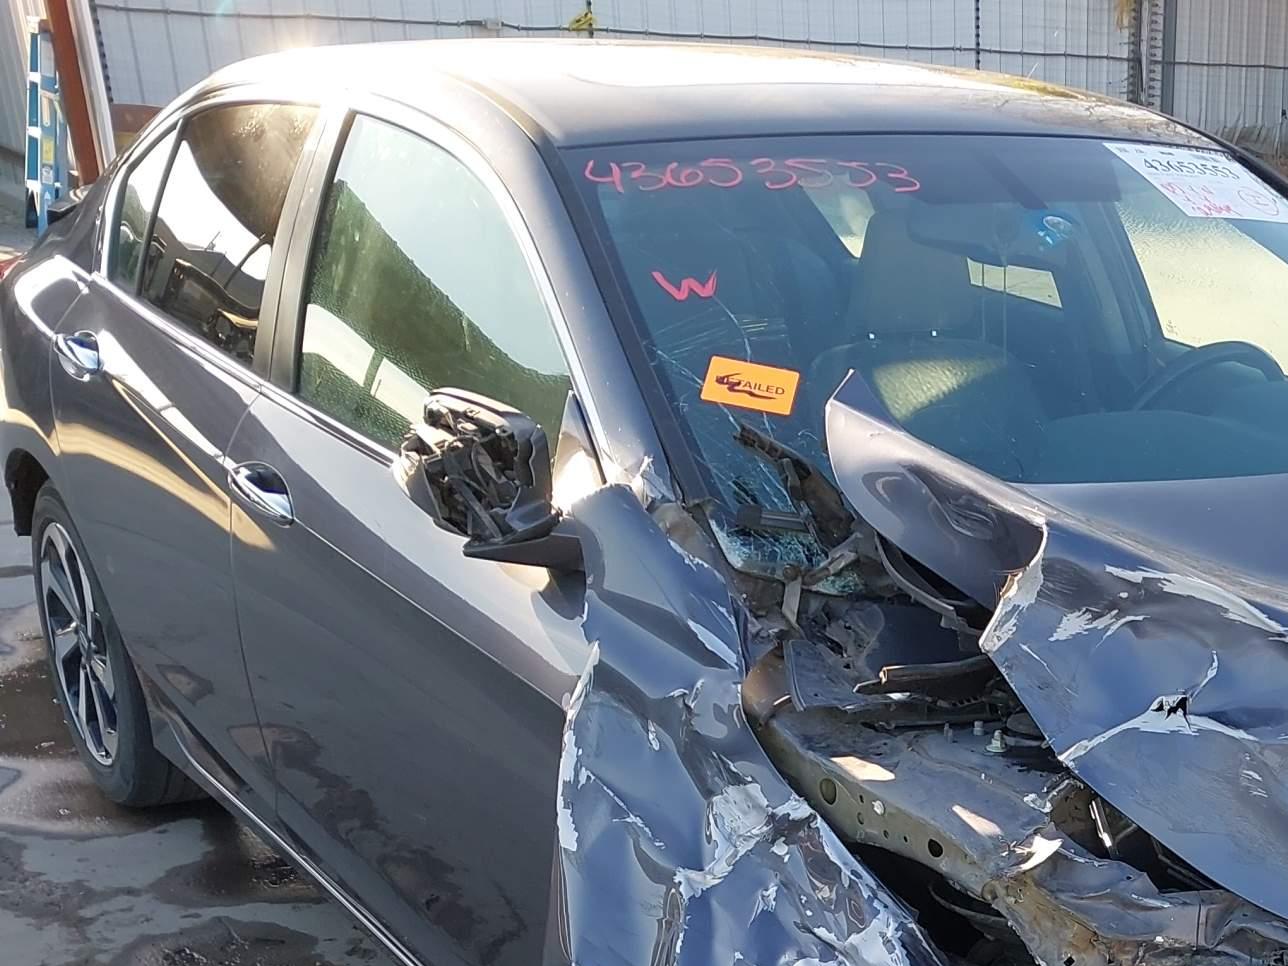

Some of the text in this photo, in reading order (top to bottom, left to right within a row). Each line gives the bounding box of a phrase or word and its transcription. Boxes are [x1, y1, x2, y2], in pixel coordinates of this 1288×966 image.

[584, 158, 921, 193] 43653553
[652, 268, 717, 301] W
[716, 375, 785, 396] AILED
